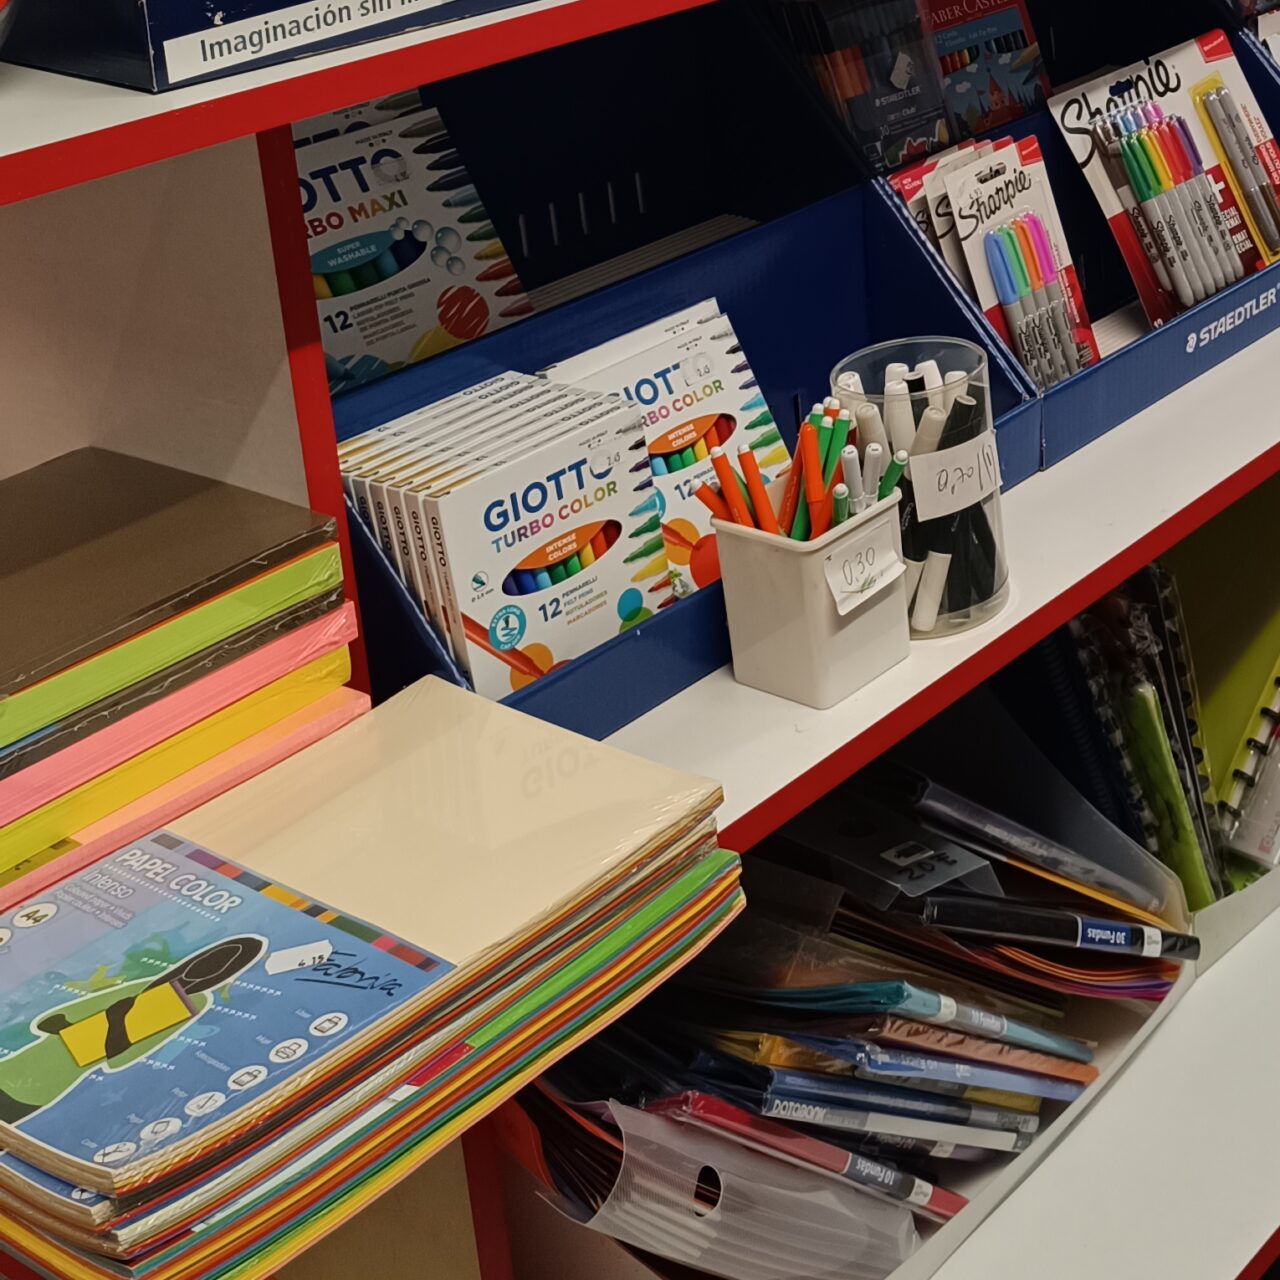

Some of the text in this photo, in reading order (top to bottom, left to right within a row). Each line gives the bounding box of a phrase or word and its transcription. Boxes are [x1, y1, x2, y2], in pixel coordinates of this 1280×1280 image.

[201, 4, 351, 62] Imaginación
[298, 149, 403, 214] OTT
[347, 189, 409, 223] MAXI
[958, 167, 1033, 242] Sharpie
[327, 244, 378, 268] WASHABLE
[336, 241, 361, 255] SUPER
[323, 310, 354, 334] 12
[1199, 288, 1277, 346] STAEDTLER
[624, 363, 680, 405] IOT
[672, 379, 725, 412] COLOR
[376, 500, 392, 552] GIOTTO
[393, 505, 410, 557] GIOTTO
[491, 480, 618, 553] TURBO COLOR
[411, 510, 427, 562] GIOTTO
[430, 516, 446, 568] GIOTTO
[545, 532, 577, 553] INTENSE
[548, 542, 578, 562] COLORS
[538, 597, 563, 623] 12
[115, 849, 177, 883] PAPEL
[169, 873, 243, 914] COLOR
[21, 909, 49, 925] A4
[1086, 928, 1116, 945] Fundas
[855, 1158, 896, 1186] 10 Fundas
